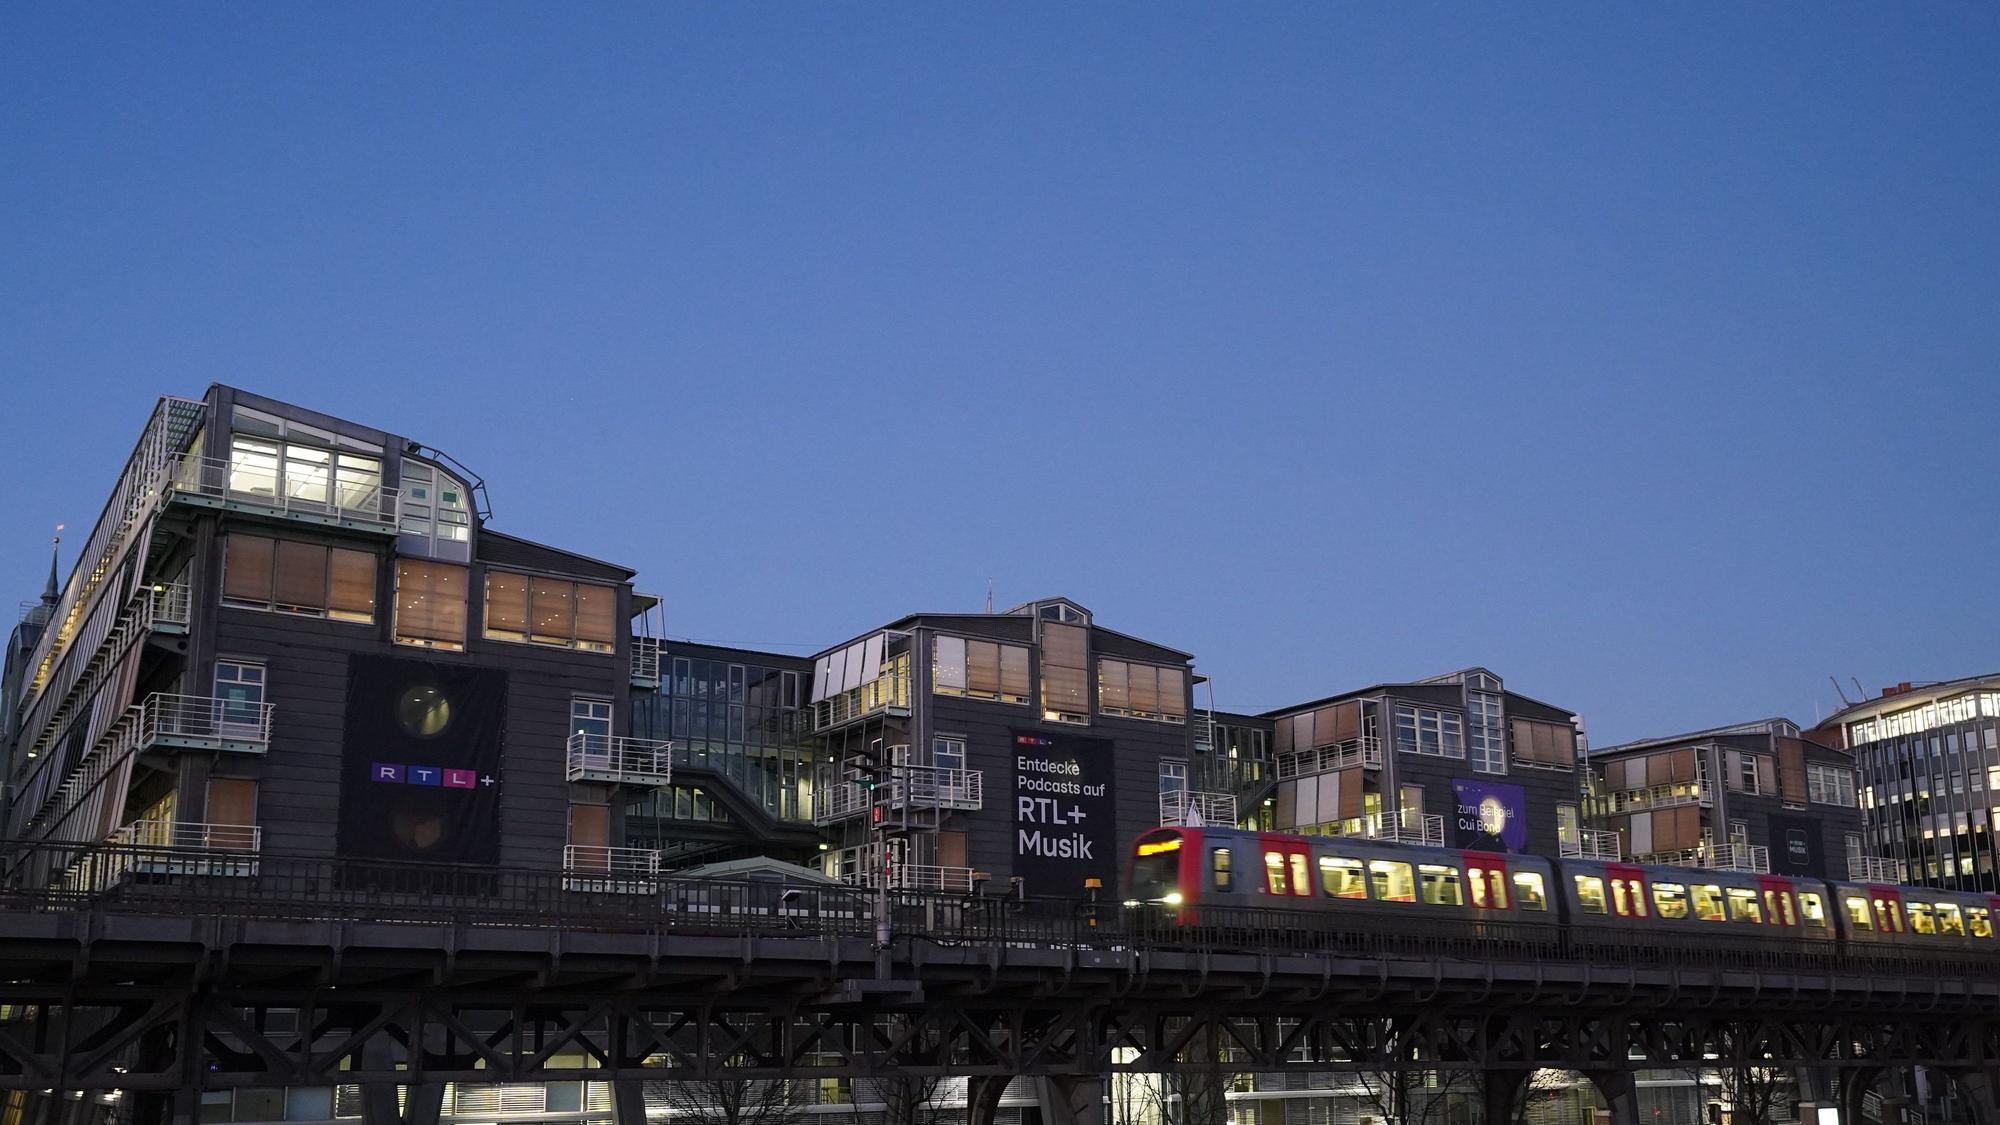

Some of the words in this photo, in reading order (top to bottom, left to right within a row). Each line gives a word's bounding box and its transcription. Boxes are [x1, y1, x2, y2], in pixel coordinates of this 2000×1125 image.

[1017, 756, 1080, 776] Entdecke
[380, 767, 495, 786] RTL+
[1017, 775, 1081, 795] Podcasts
[1083, 783, 1106, 797] auf
[1018, 796, 1087, 825] RTL+
[1458, 804, 1478, 816] zum
[1459, 818, 1475, 831] Cui
[1018, 829, 1093, 860] Musik
